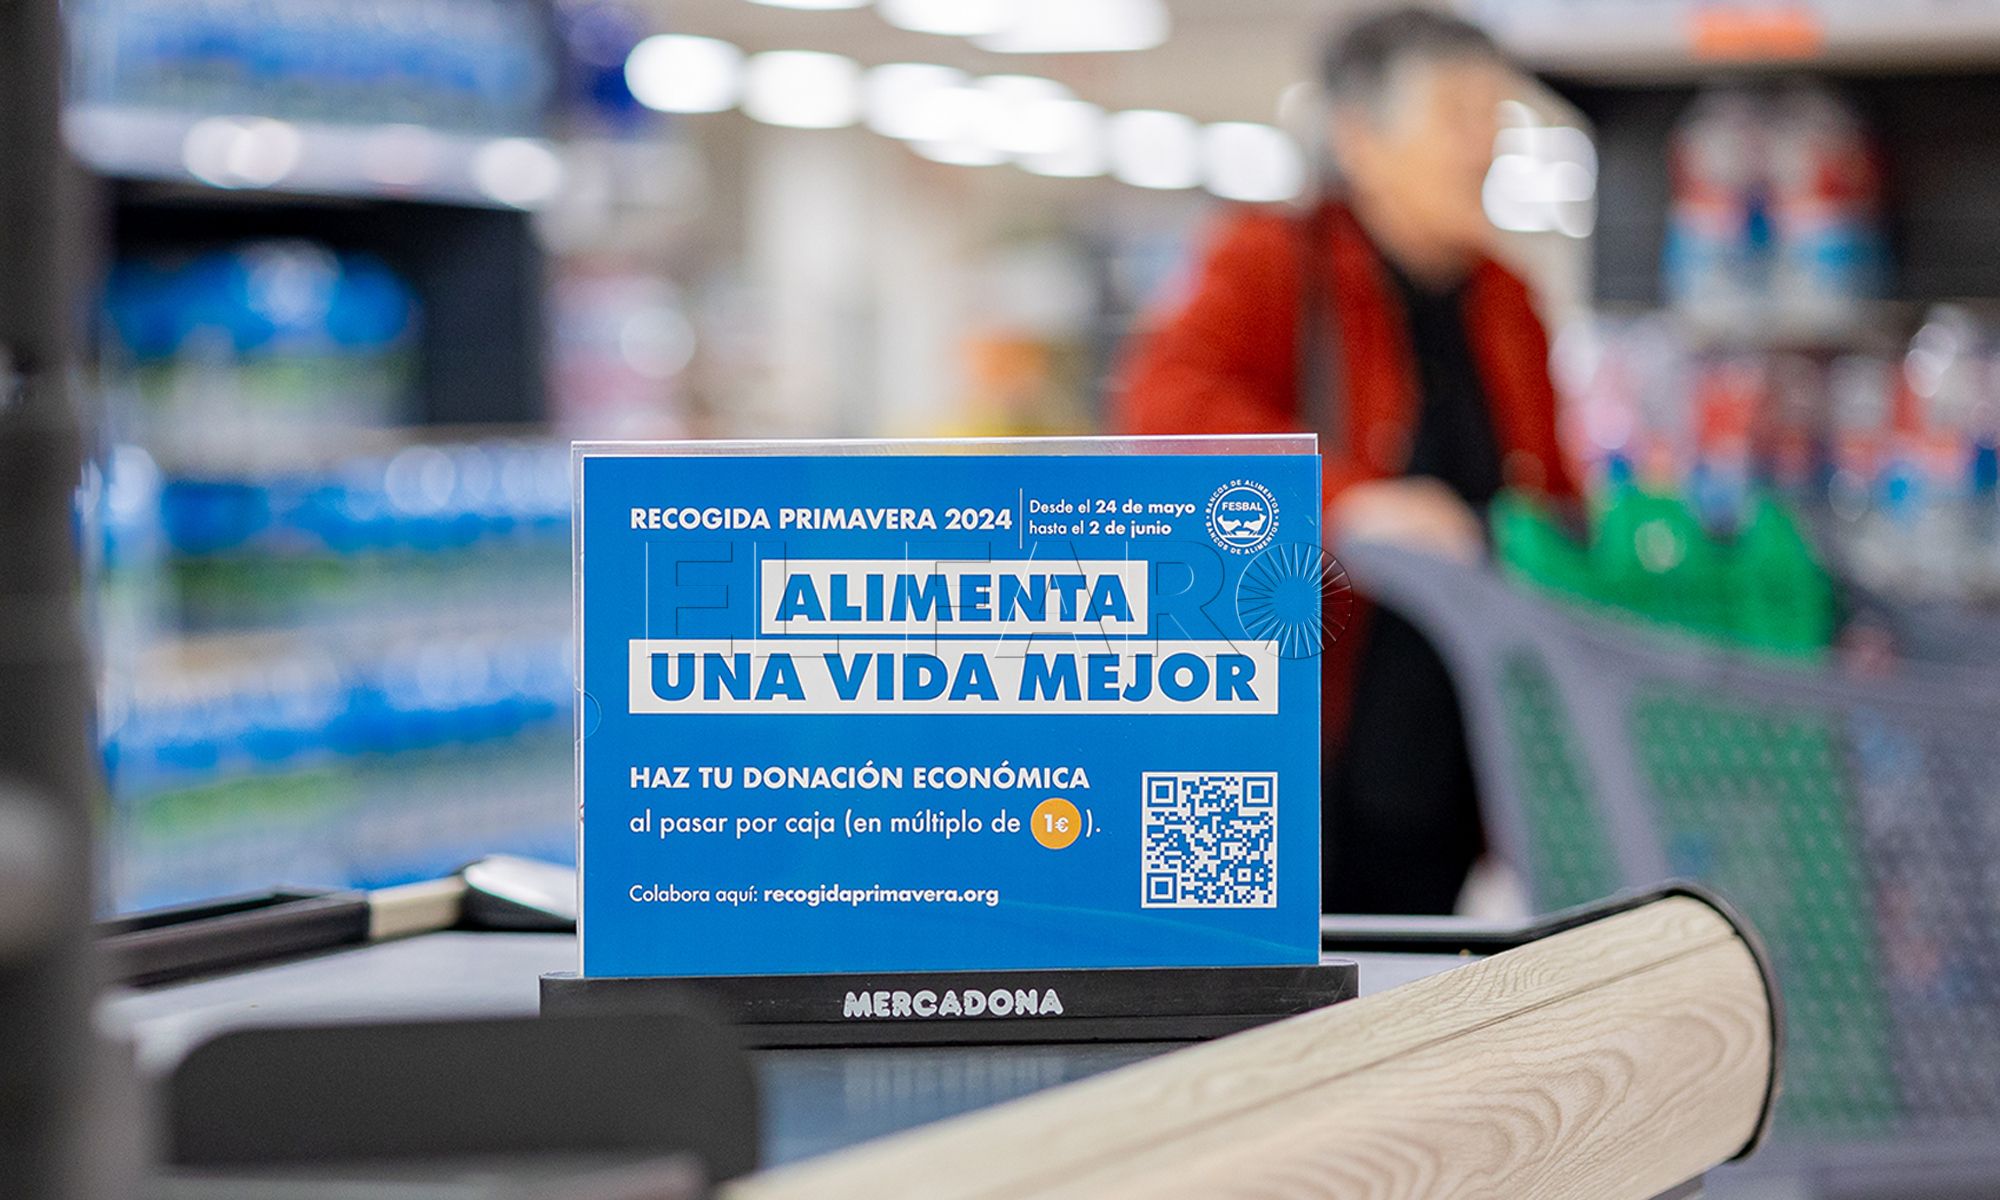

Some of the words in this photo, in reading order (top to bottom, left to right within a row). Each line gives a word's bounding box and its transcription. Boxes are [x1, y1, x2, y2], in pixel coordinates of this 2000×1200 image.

[1028, 498, 1074, 515] Desde
[1077, 498, 1092, 514] el
[1095, 498, 1118, 514] 24
[1121, 498, 1144, 514] de
[1147, 502, 1197, 518] mayo
[1205, 483, 1229, 514] BANCOS
[1230, 479, 1242, 487] DE
[1244, 479, 1280, 515] ALIMENTOS
[1221, 501, 1263, 511] FESBAL
[629, 507, 771, 531] RECOGIDA
[778, 507, 939, 531] PRIMAVERA
[943, 507, 1013, 531] 2024
[1028, 519, 1068, 535] hasta
[1071, 519, 1085, 535] el
[1089, 519, 1101, 535] 2
[1104, 519, 1127, 535] de
[1130, 519, 1173, 539] junio
[1205, 521, 1229, 552] BANCOS
[1230, 547, 1242, 555] DE
[1244, 520, 1280, 556] ALIMENTOS
[774, 572, 1136, 624] ALIMENTA
[649, 651, 807, 703] UNA
[821, 651, 1000, 702] VIDA
[1017, 651, 1260, 703] MEJOR
[629, 765, 690, 790] HAZ
[697, 765, 734, 790] TU
[742, 758, 904, 790] DONACIÓN
[912, 759, 1091, 790] ECONÓMICA
[629, 807, 652, 834] al
[659, 816, 729, 840] pasar
[735, 816, 779, 840] por
[784, 809, 836, 841] caja
[844, 807, 883, 839] (en
[889, 807, 984, 841] múltiplo
[990, 807, 1021, 834] de
[1043, 813, 1069, 833] 1€
[628, 882, 711, 903] Colabora
[714, 884, 759, 908] aquí:
[763, 882, 1000, 908] recogidaprimavera.org
[842, 988, 1065, 1018] MERCADONA
